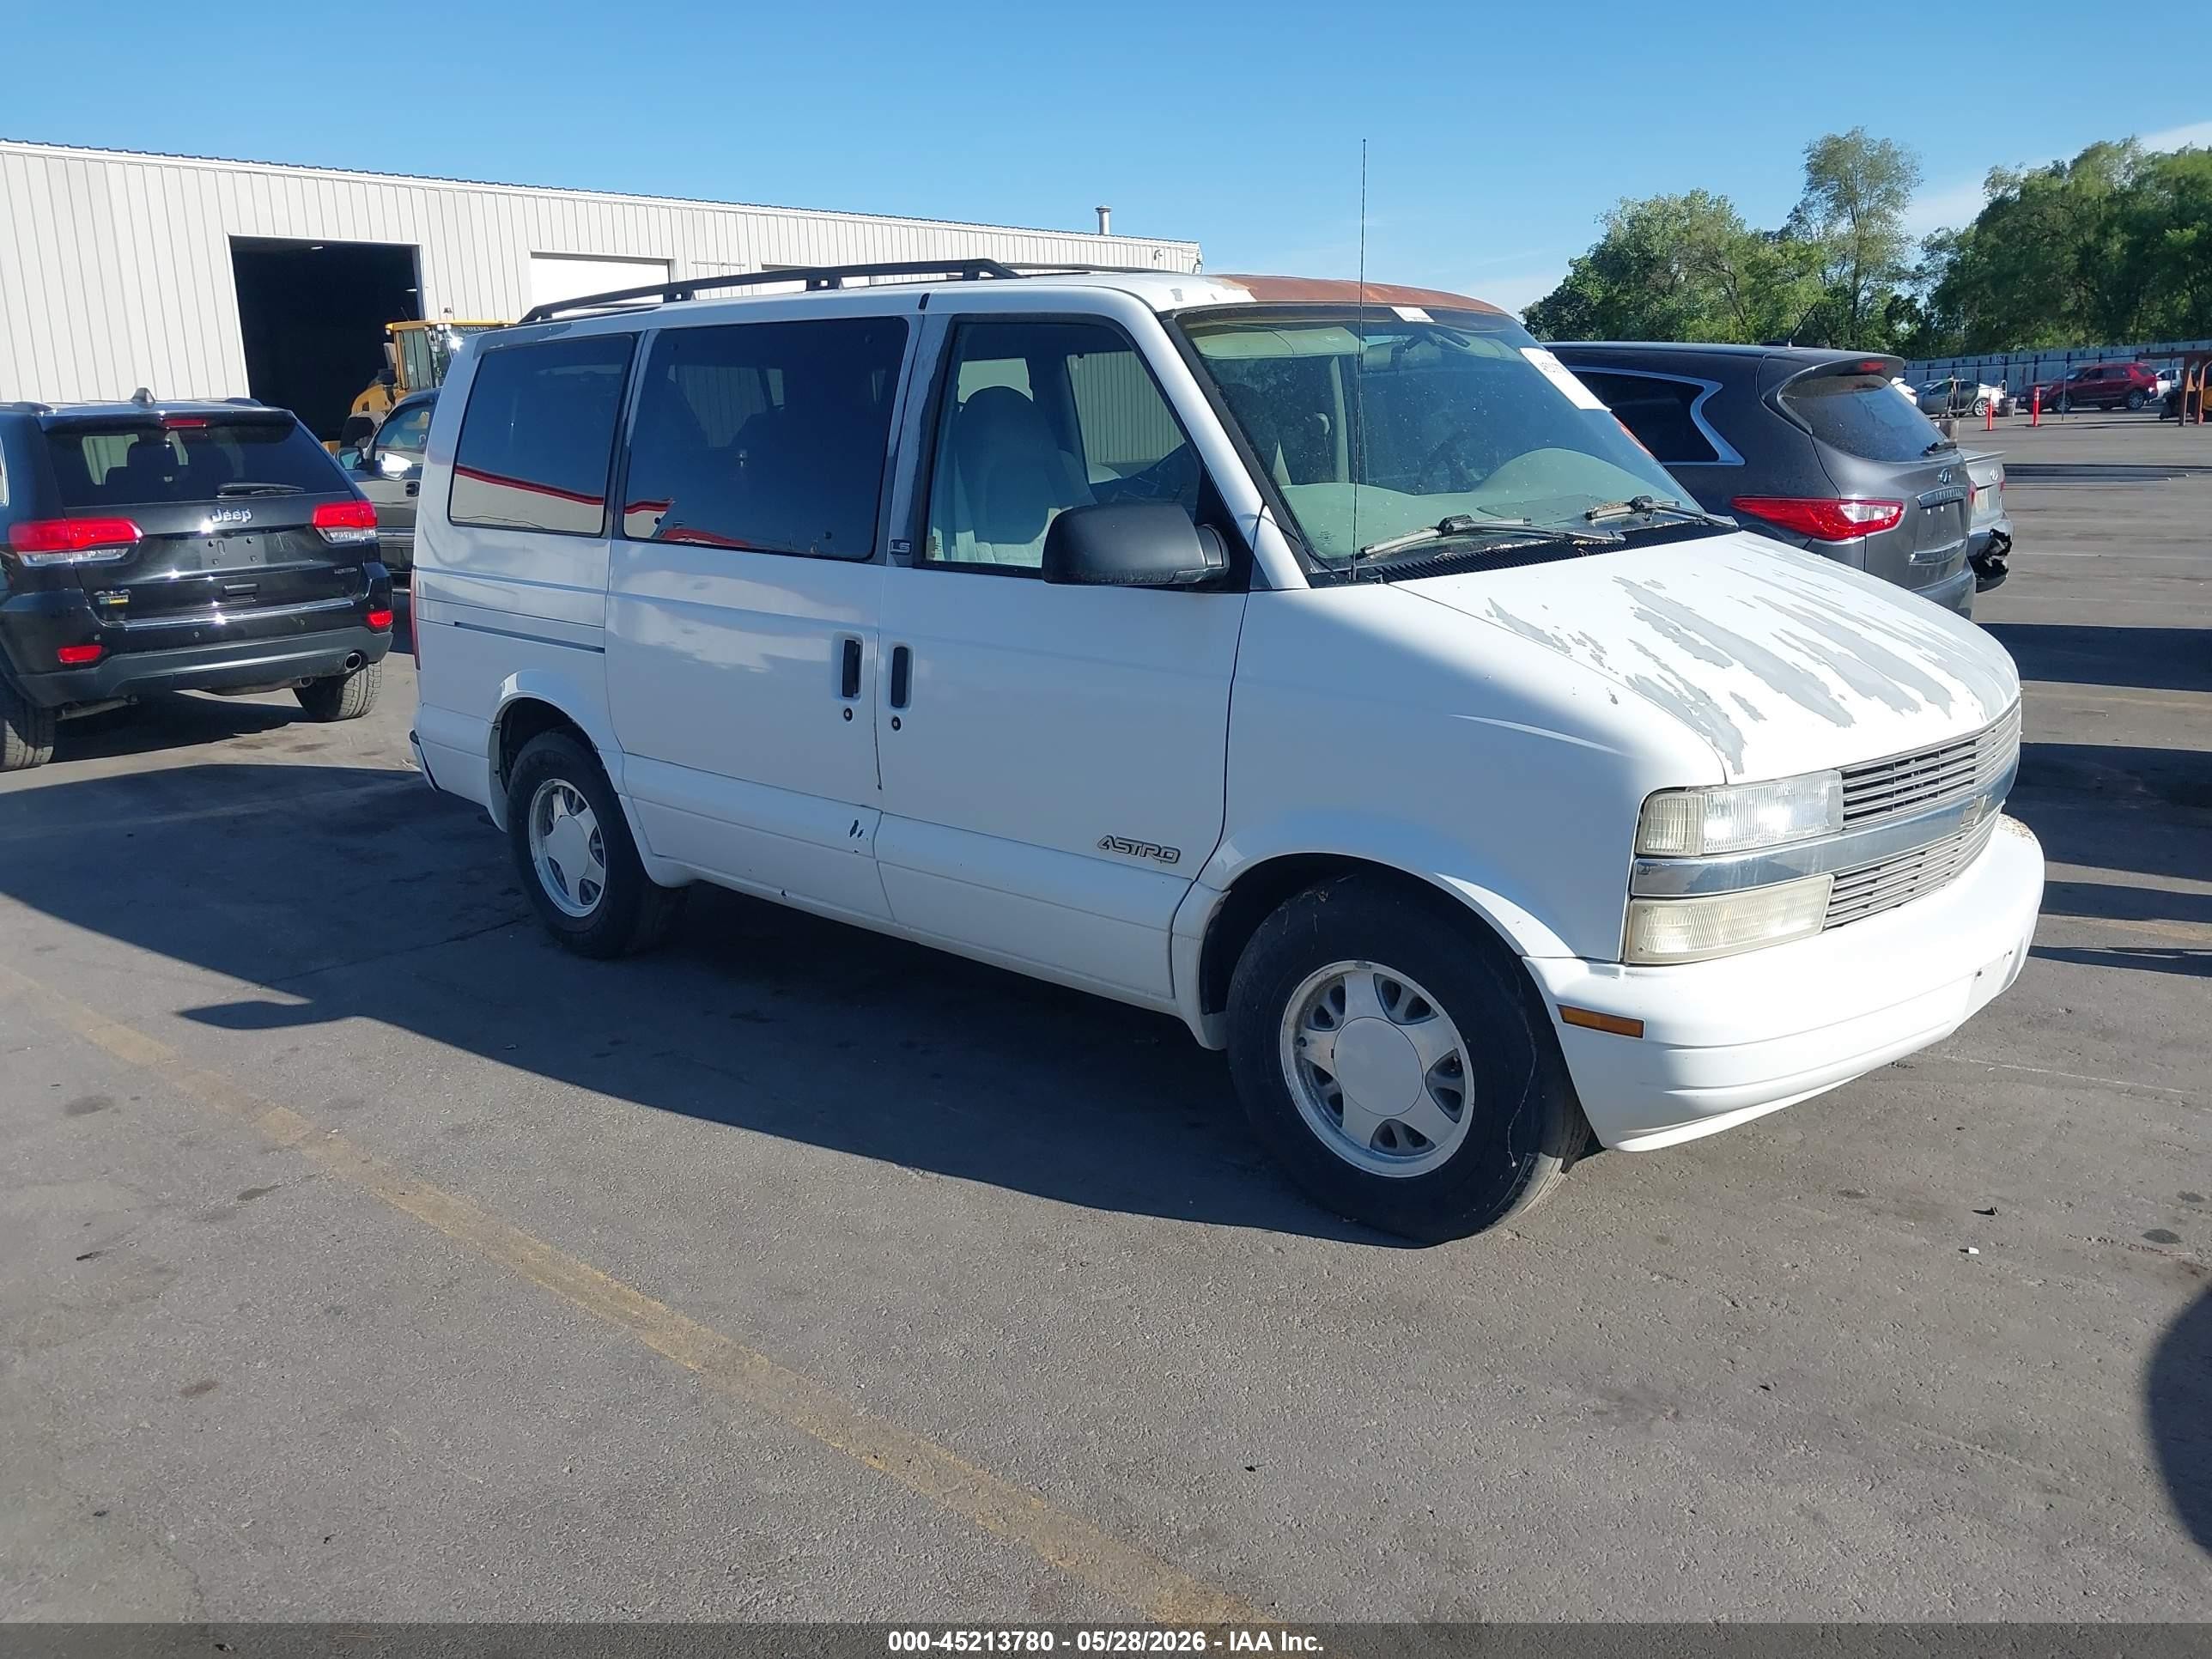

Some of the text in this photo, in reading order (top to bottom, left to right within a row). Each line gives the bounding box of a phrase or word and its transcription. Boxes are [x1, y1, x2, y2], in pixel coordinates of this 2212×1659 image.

[211, 507, 252, 523] Jeep
[890, 542, 910, 554] LS
[1098, 835, 1181, 864] ASTRO
